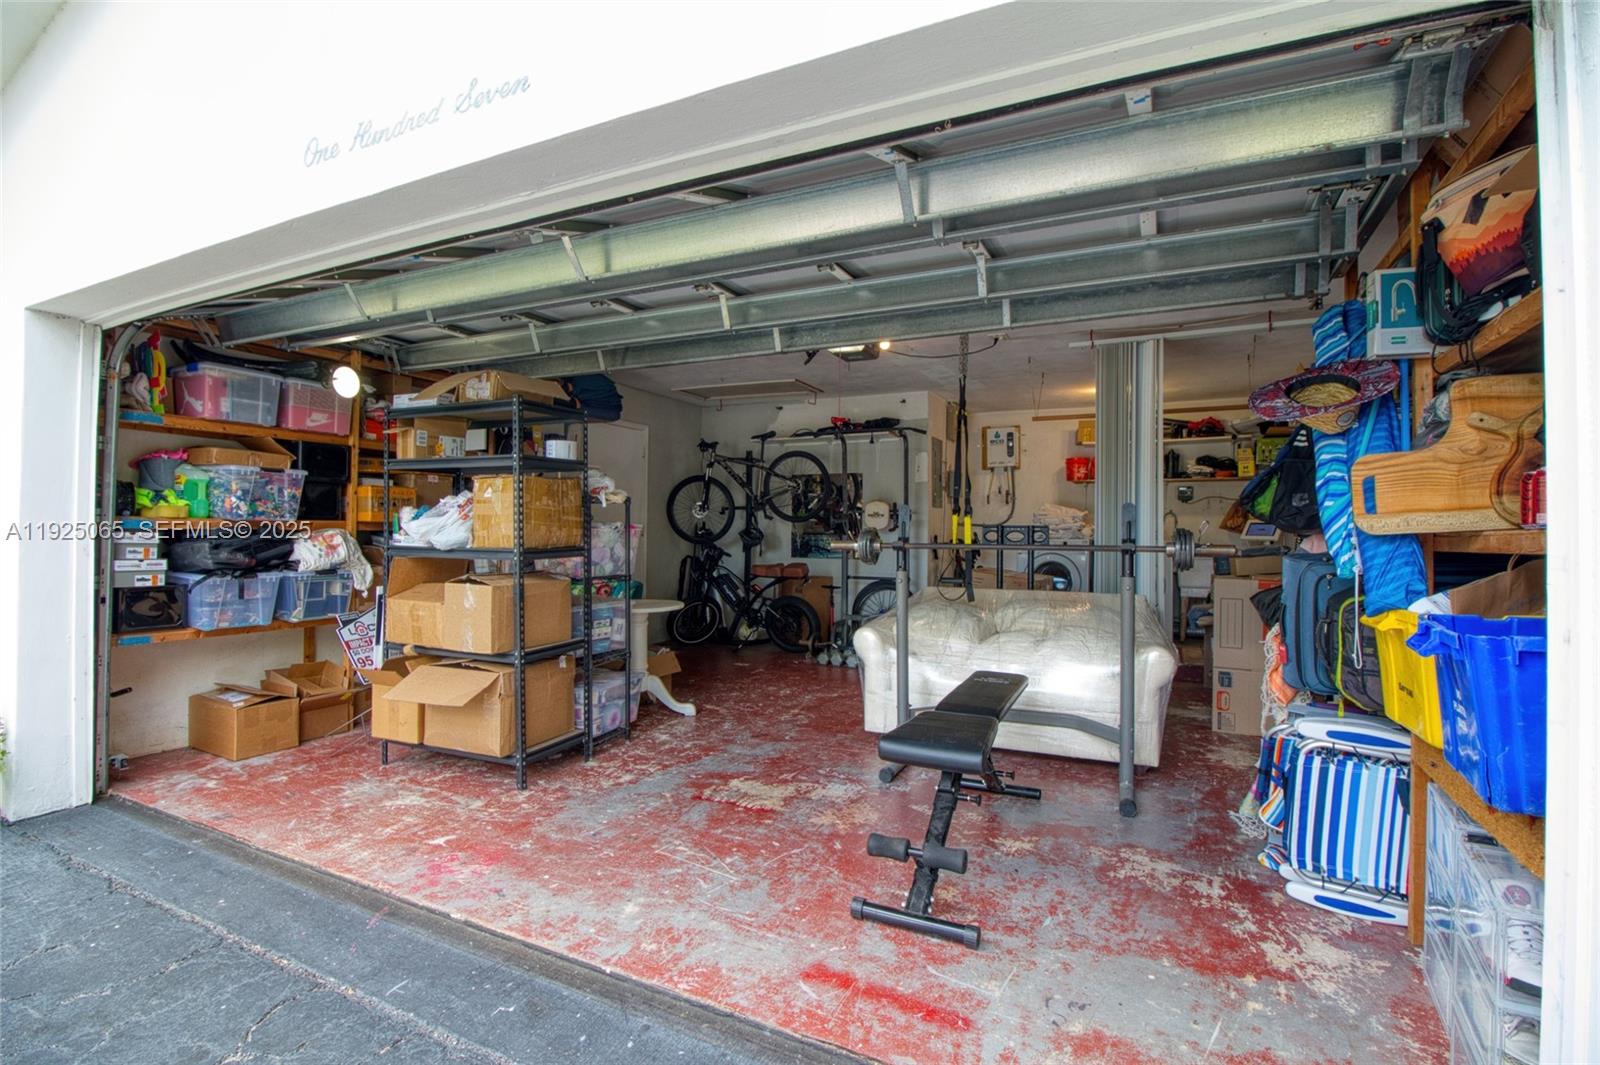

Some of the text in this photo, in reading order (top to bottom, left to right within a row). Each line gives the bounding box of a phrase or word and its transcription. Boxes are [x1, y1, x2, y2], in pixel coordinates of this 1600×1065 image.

[304, 75, 532, 168] One Hundred Seven
